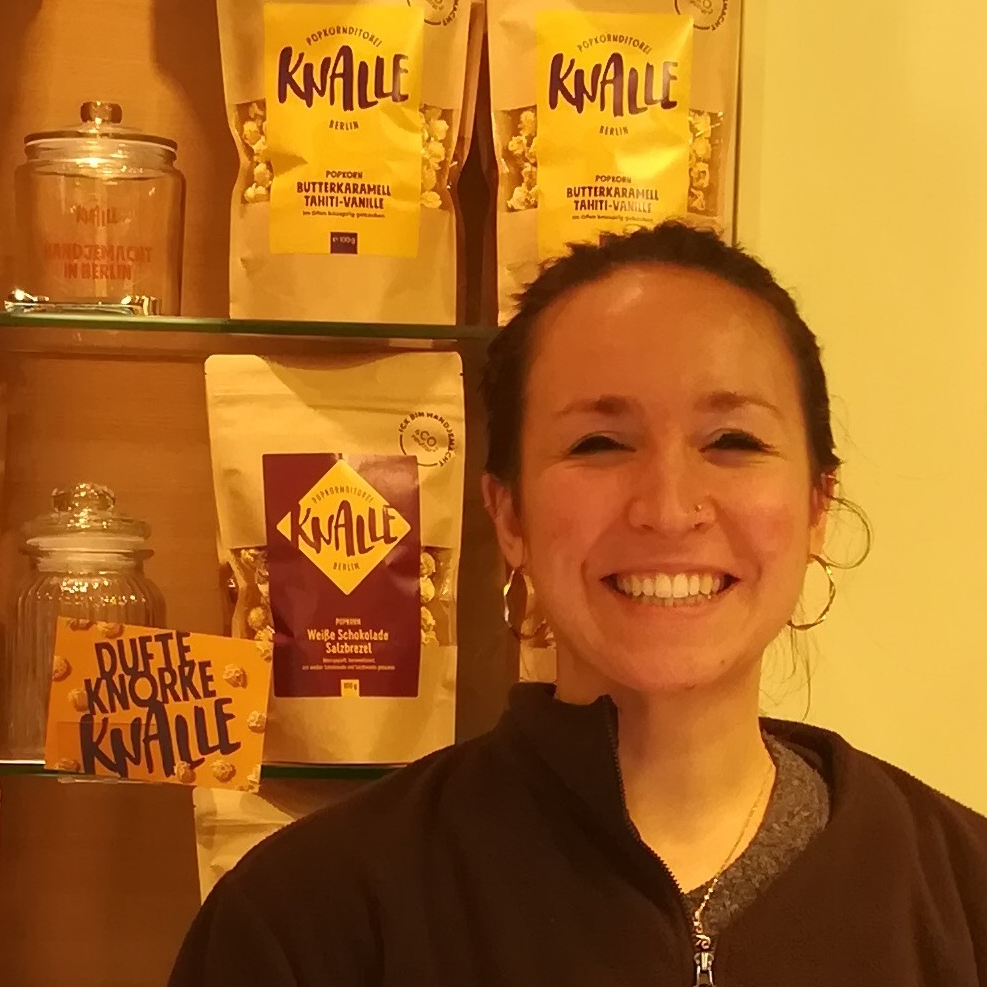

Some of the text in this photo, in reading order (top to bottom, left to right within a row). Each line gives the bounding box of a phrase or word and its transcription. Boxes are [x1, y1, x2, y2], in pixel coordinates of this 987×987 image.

[278, 45, 409, 112] KNALLE
[549, 52, 679, 118] KNALLE
[328, 119, 360, 131] BERLIN
[599, 125, 629, 136] BERLIN
[325, 170, 363, 179] POPKORN
[595, 175, 632, 183] POPKORN
[297, 181, 392, 197] BUTTERKARAMELL
[566, 186, 659, 201] BUTTERKARAMELL
[304, 195, 384, 210] TAHITI-VANILLE
[573, 200, 652, 214] TAHITI-VANILLE
[81, 263, 132, 280] BERLIN
[288, 499, 400, 558] KNALLE
[307, 628, 389, 641] Weiße Schokolade
[95, 631, 194, 680] DUFTE
[325, 642, 373, 654] Salzbrezel
[83, 660, 218, 717] KNORKE
[78, 697, 242, 779] KNALLE
